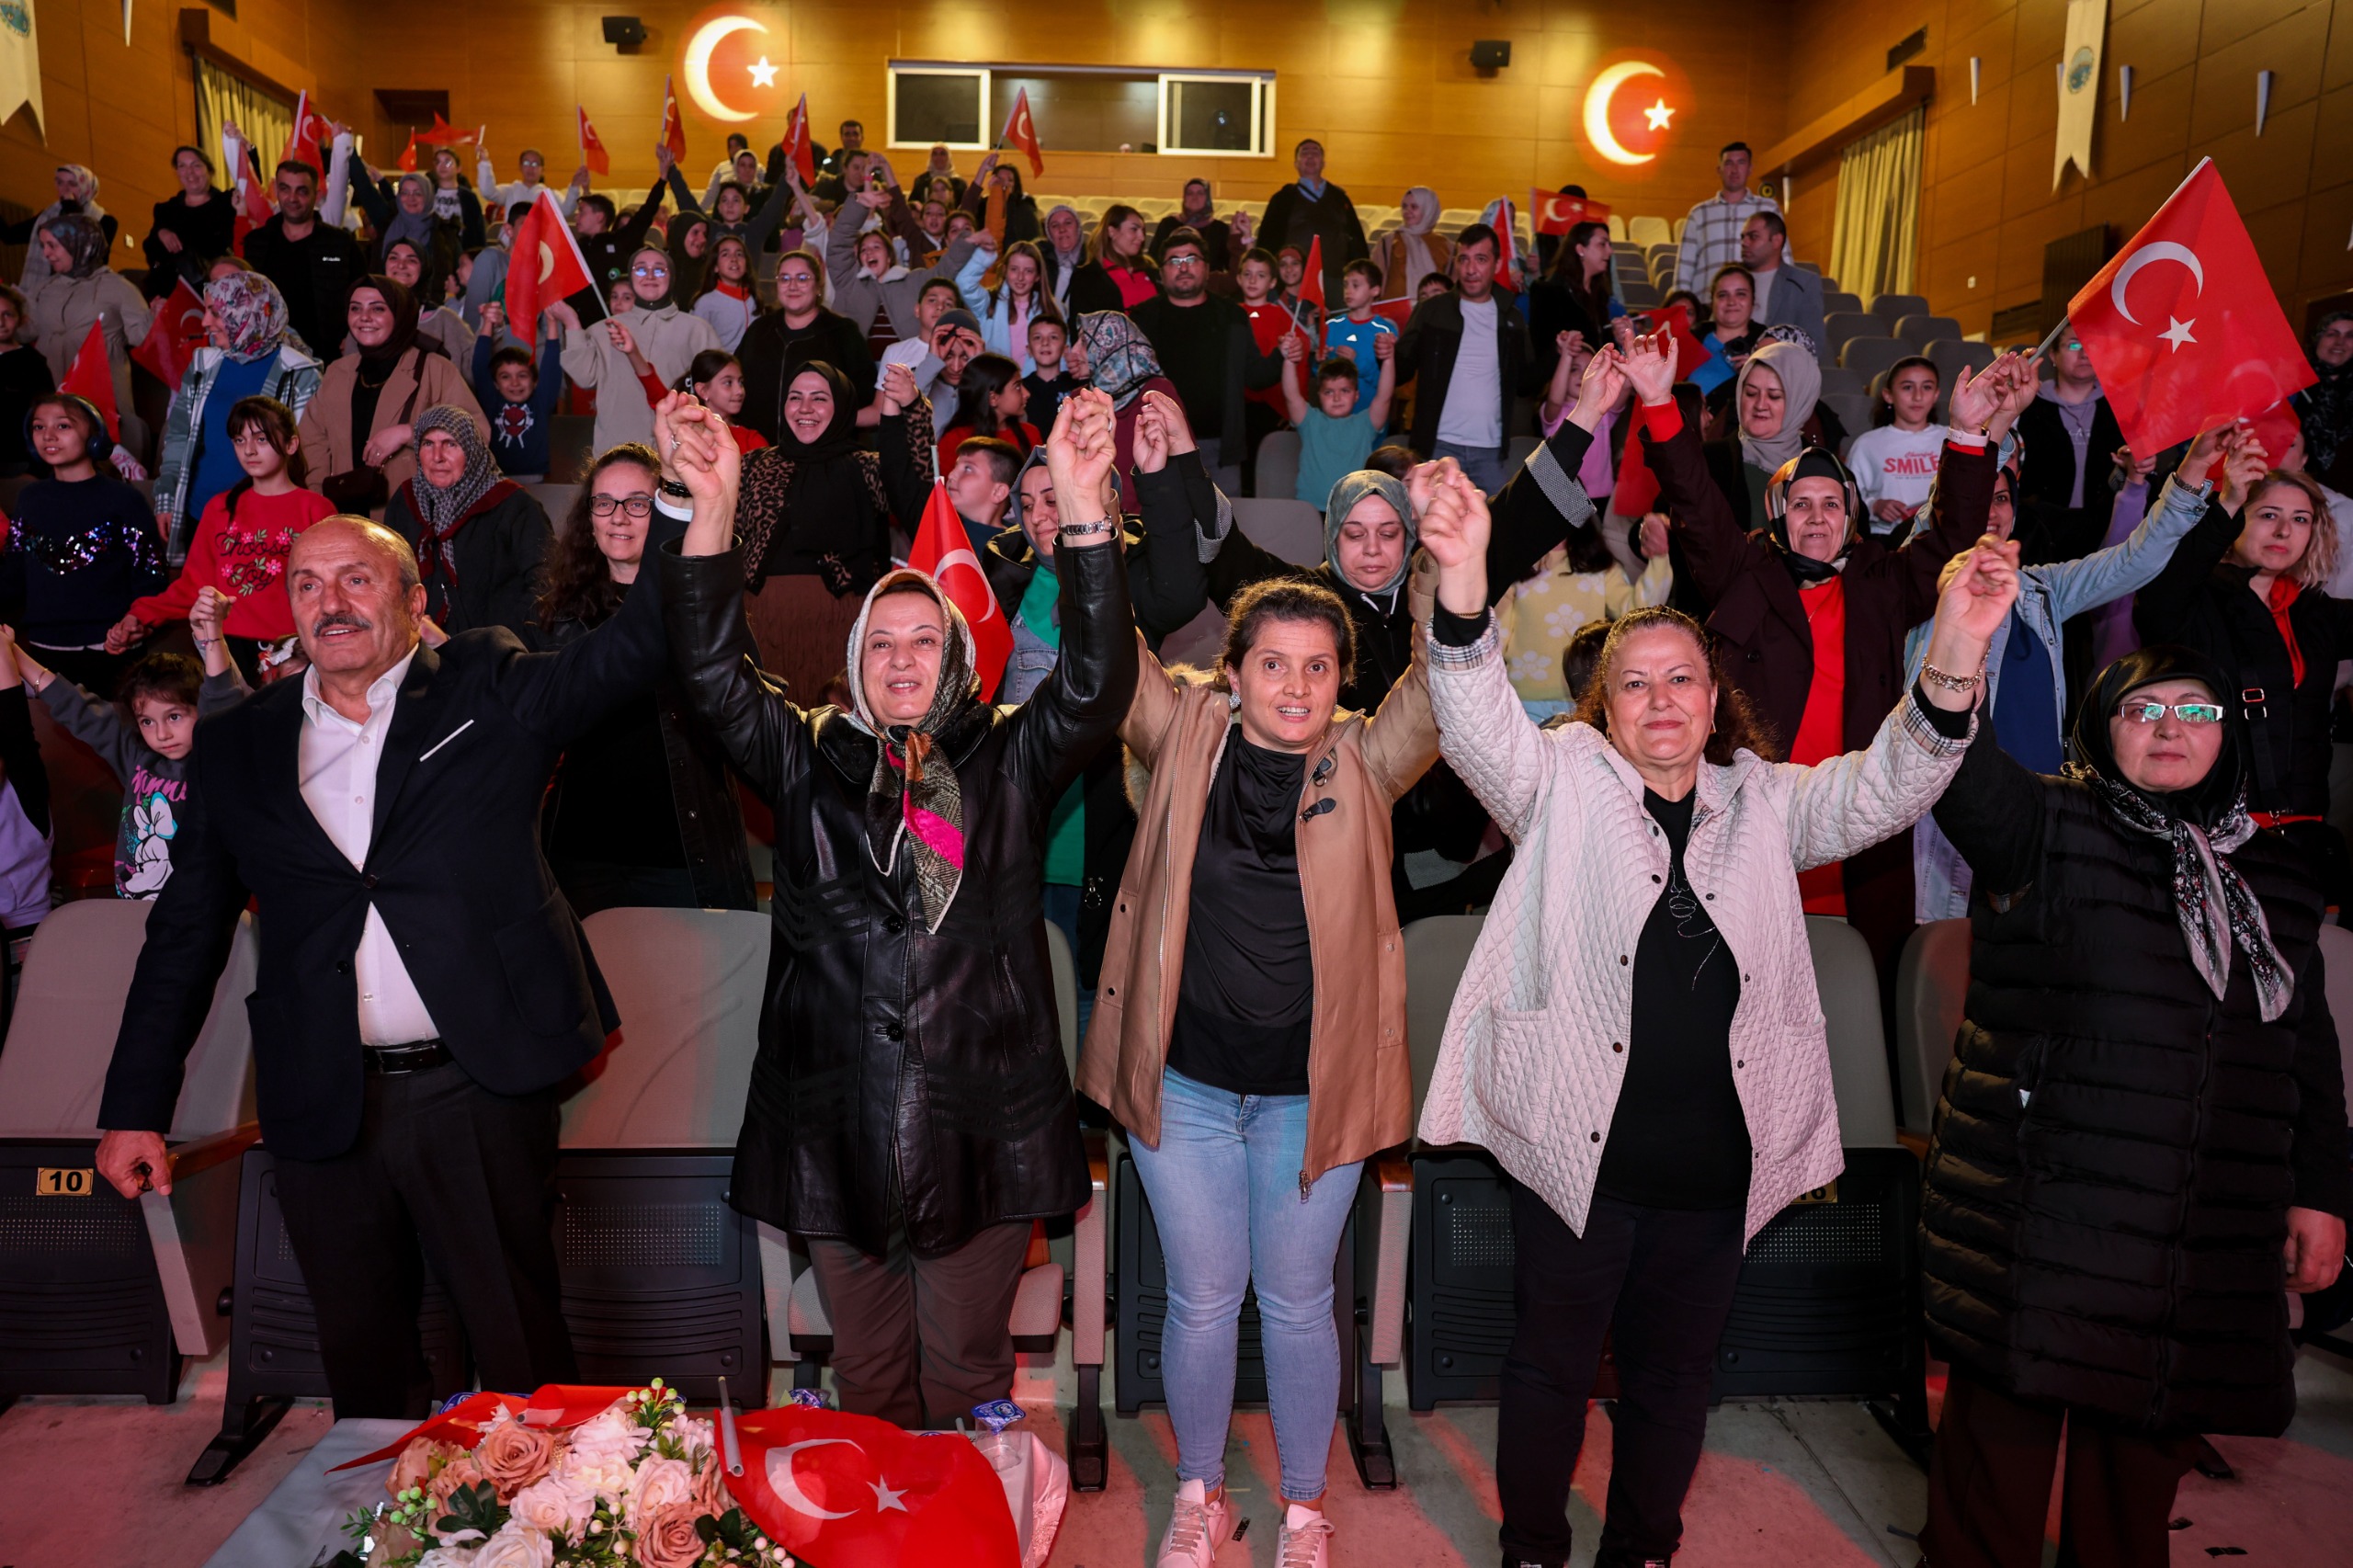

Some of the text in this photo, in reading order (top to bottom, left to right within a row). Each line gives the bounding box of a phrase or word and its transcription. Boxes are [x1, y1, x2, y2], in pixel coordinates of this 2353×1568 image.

[1883, 455, 1939, 474] SMILE
[227, 562, 275, 591] Joy
[50, 1170, 83, 1192] 10
